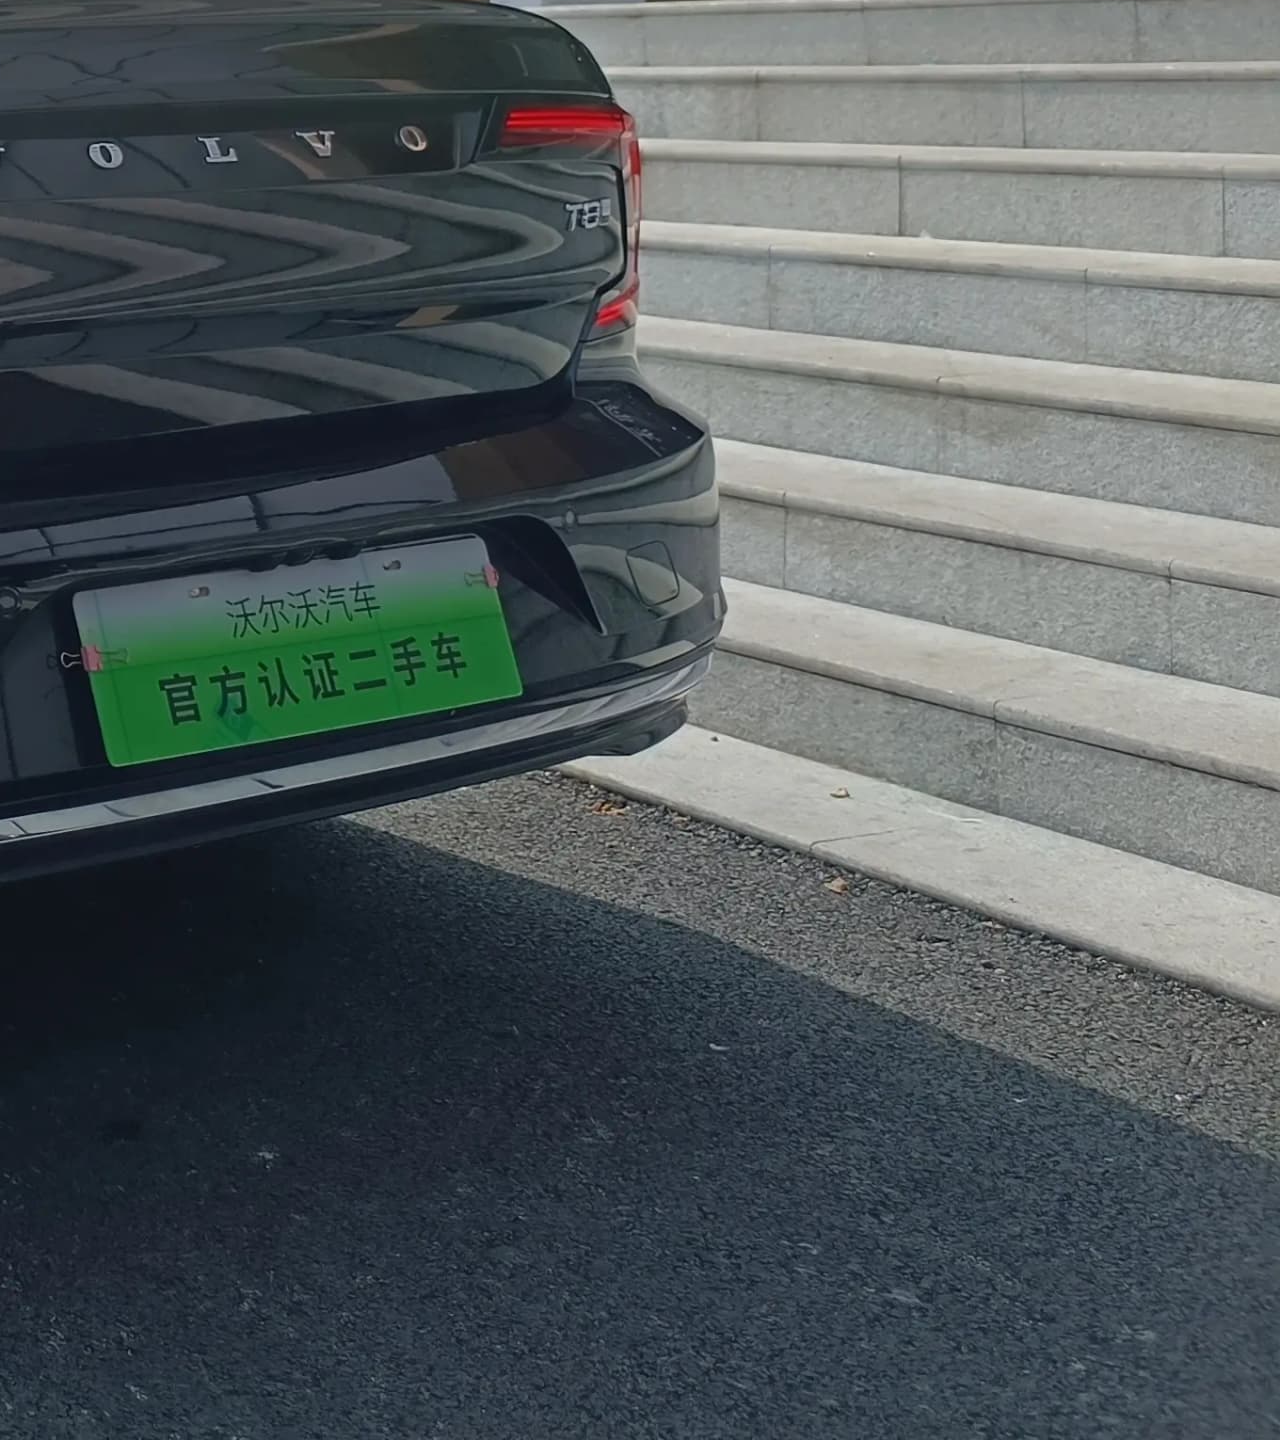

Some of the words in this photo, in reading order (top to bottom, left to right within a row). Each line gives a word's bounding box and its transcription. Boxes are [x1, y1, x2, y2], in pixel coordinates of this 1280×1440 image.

[225, 581, 381, 639] 沃尔沃汽车
[159, 631, 468, 726] 官方认证二手车
